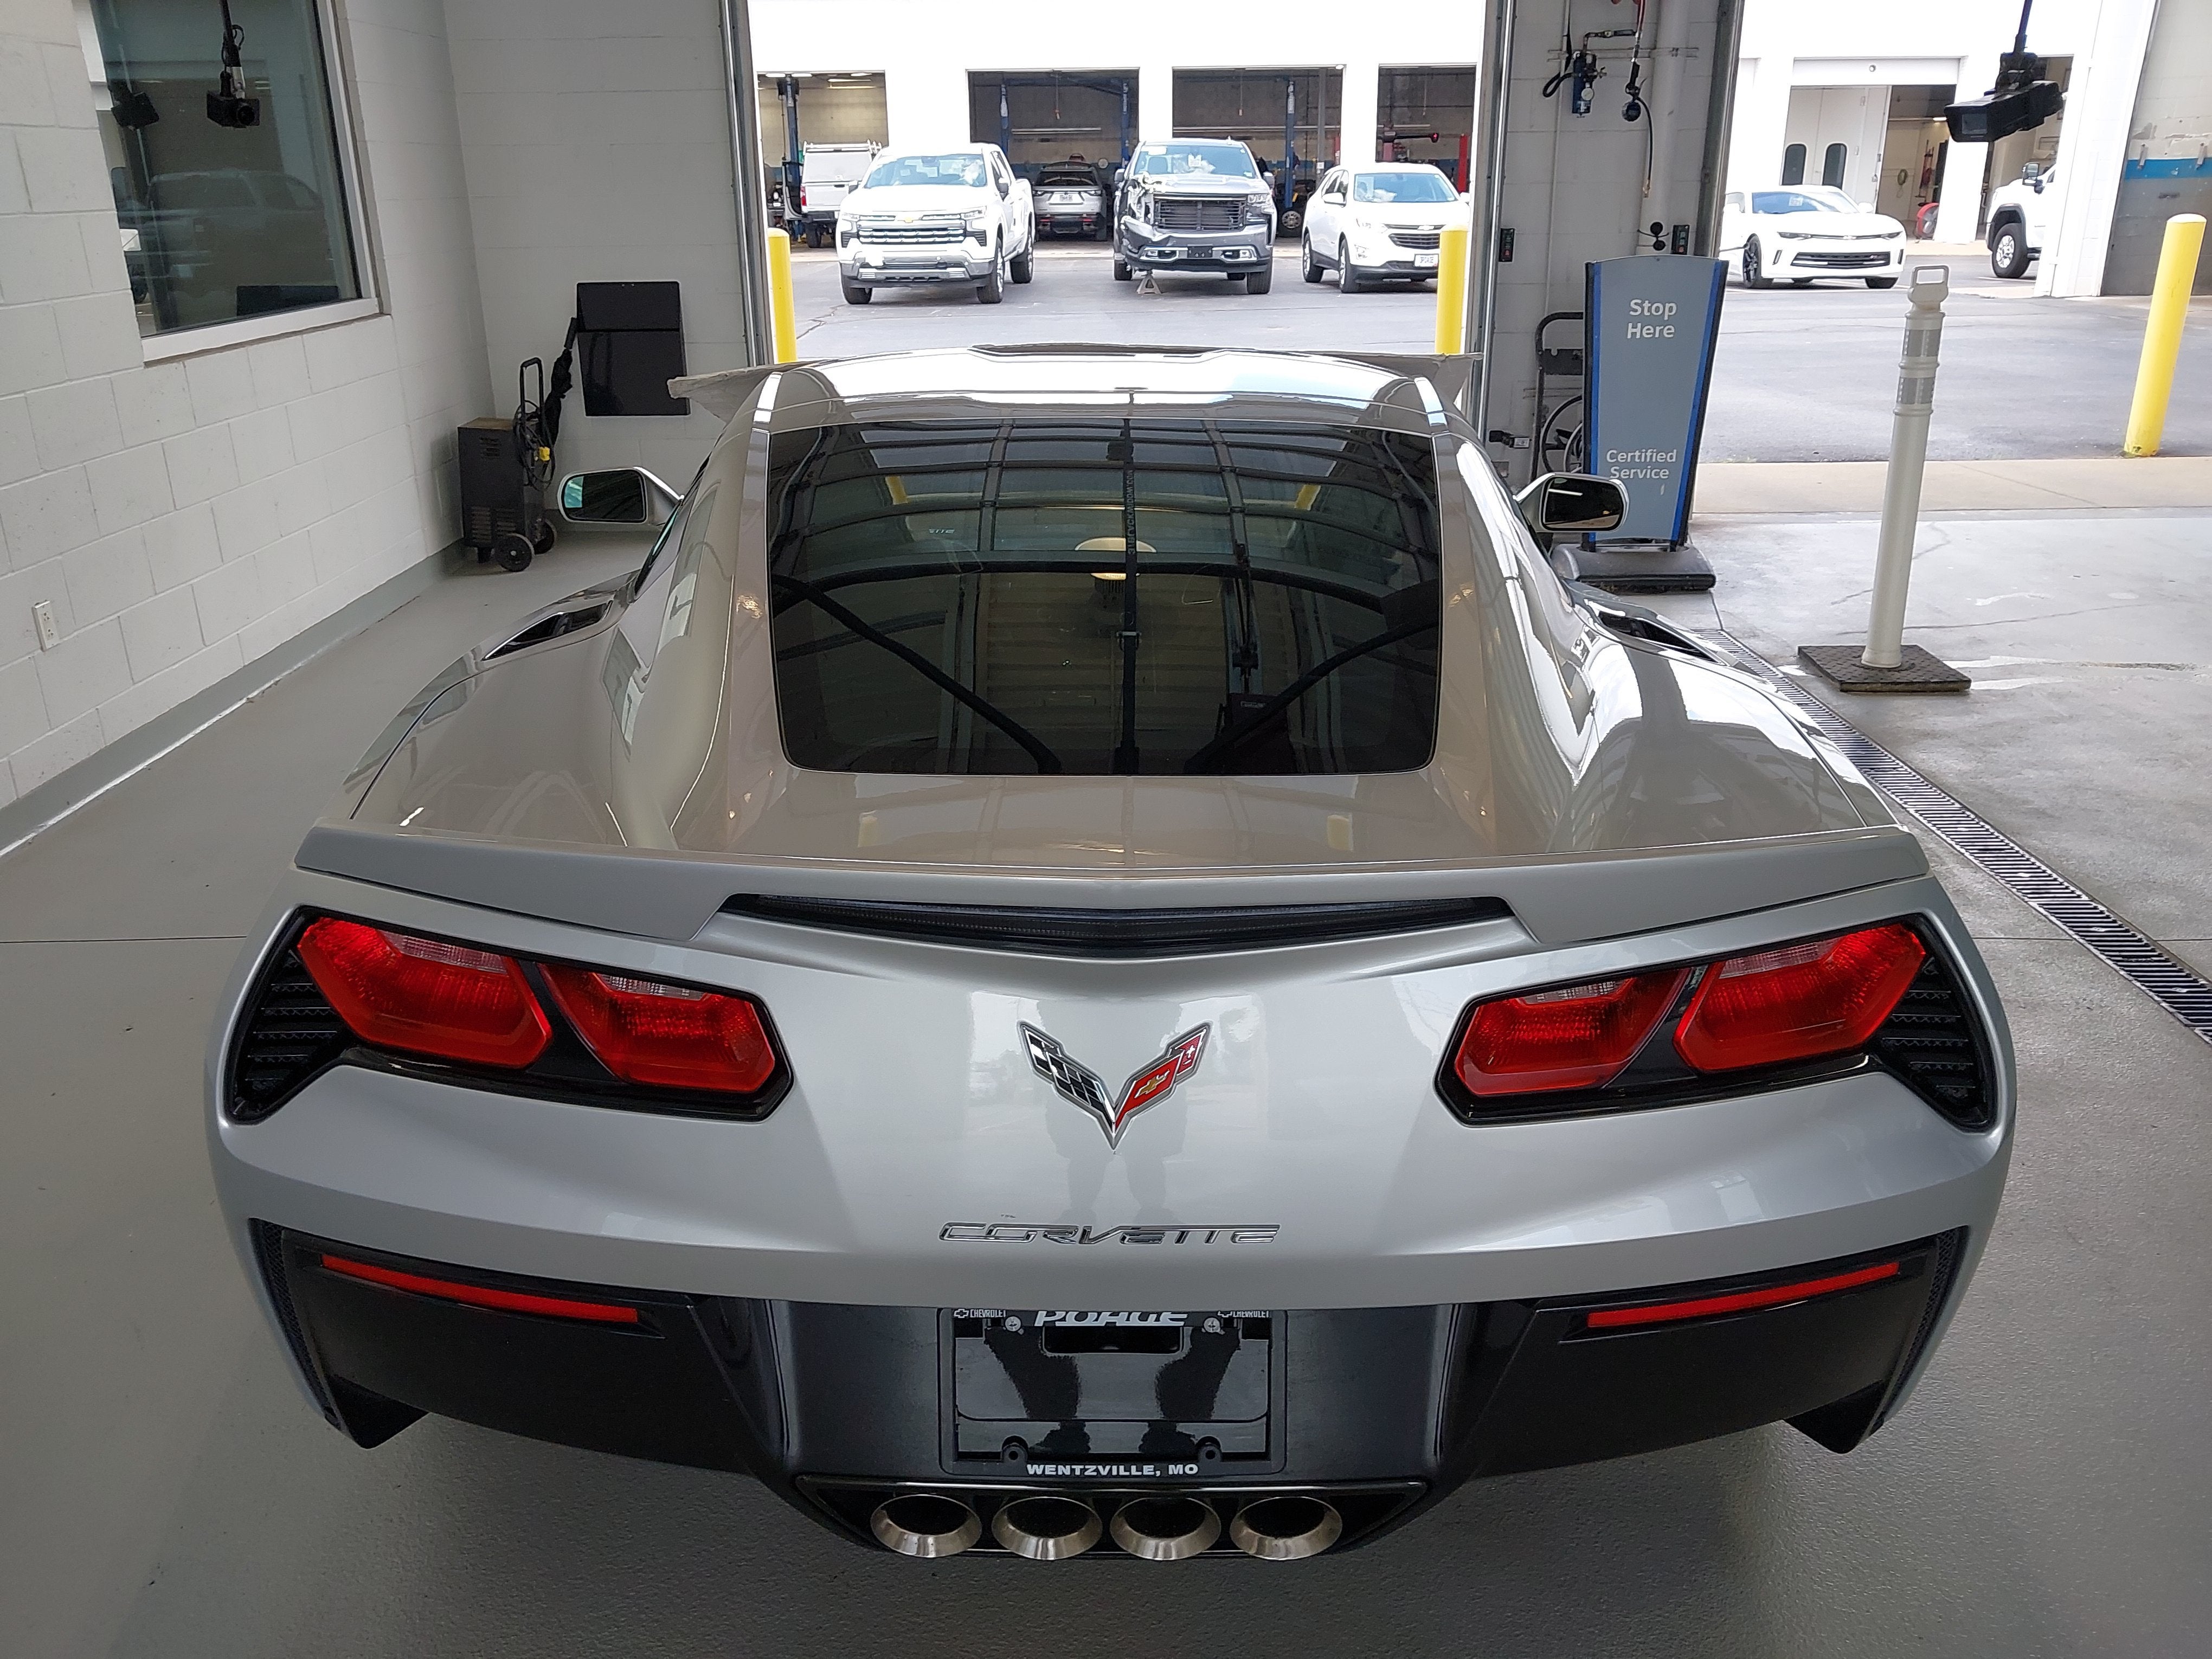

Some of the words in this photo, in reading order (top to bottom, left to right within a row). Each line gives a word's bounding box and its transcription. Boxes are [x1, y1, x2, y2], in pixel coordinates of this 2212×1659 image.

[1629, 299, 1677, 320] Stop
[1627, 323, 1675, 339] Here
[1606, 448, 1677, 462] Certified
[1610, 465, 1669, 479] Service
[939, 1223, 1281, 1244] CORVETTE
[969, 1309, 1006, 1318] CHEVROLET
[1026, 1464, 1161, 1477] WENTZVILLE,
[1168, 1464, 1199, 1475] MO
